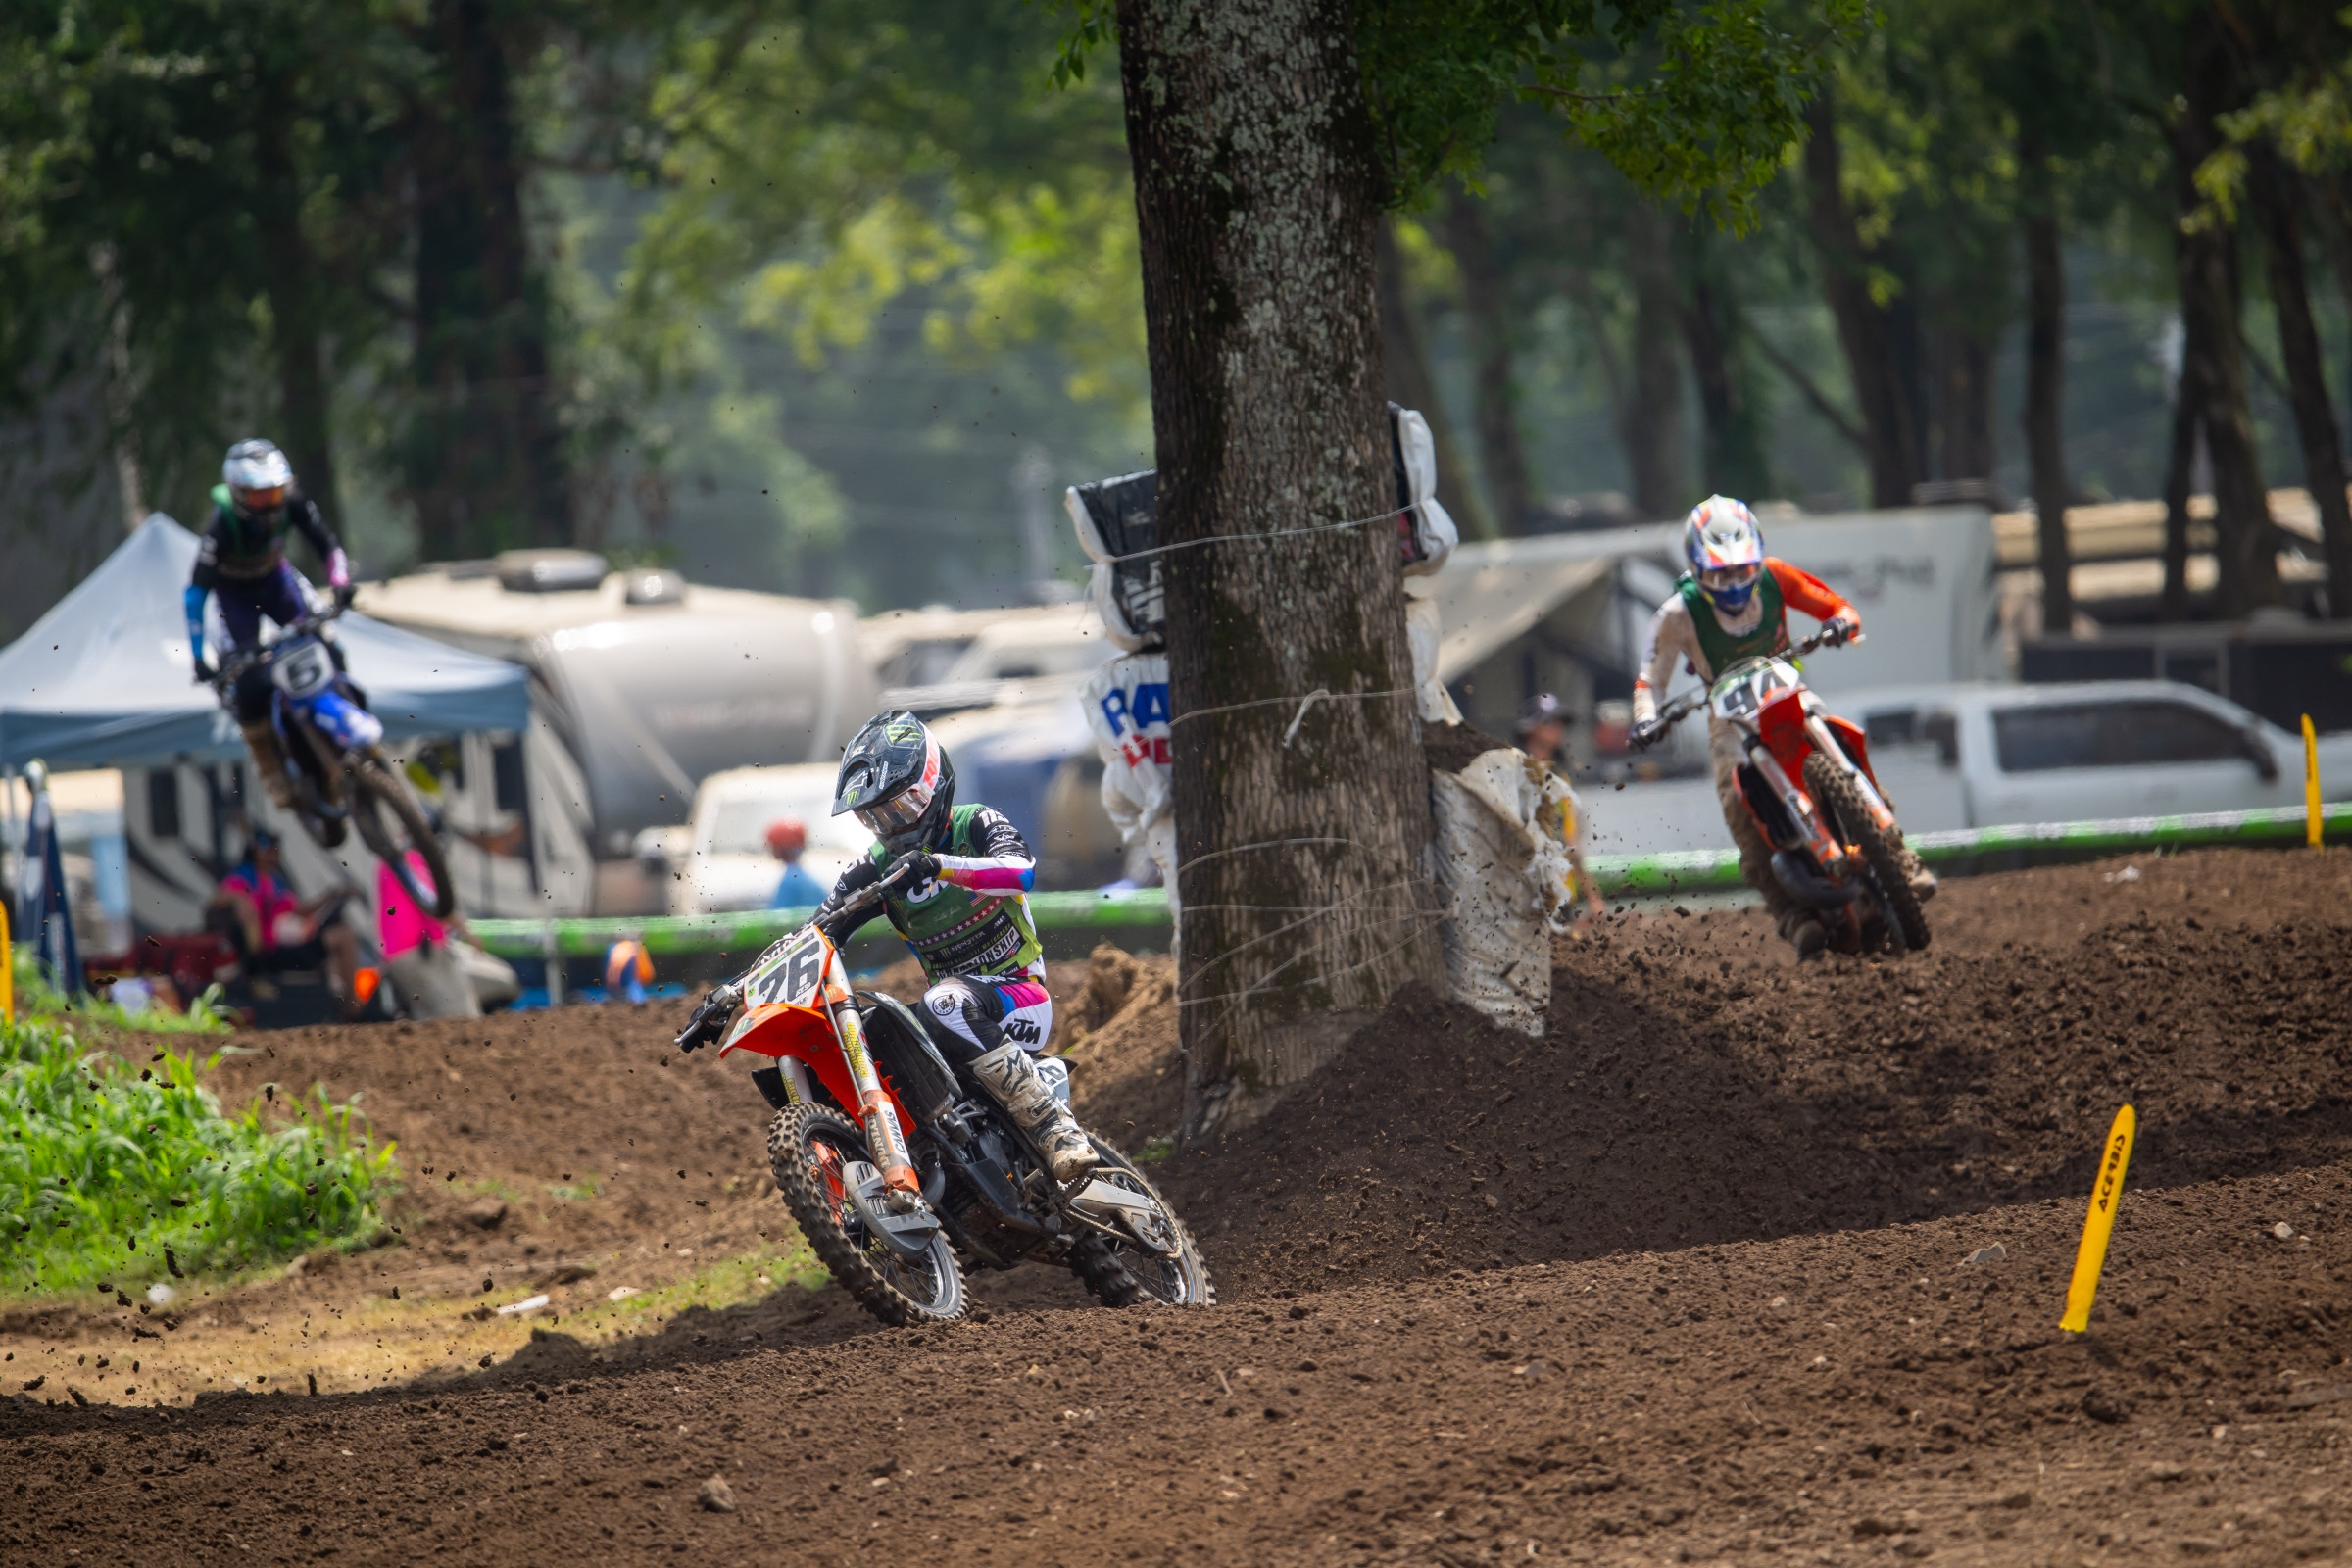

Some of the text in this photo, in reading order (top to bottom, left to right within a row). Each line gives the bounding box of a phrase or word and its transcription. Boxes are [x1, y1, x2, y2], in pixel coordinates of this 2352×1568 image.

[286, 647, 322, 692] 5
[759, 941, 820, 1004] 26
[1003, 1018, 1041, 1045] KTM
[2098, 1133, 2126, 1214] ACERBIS
